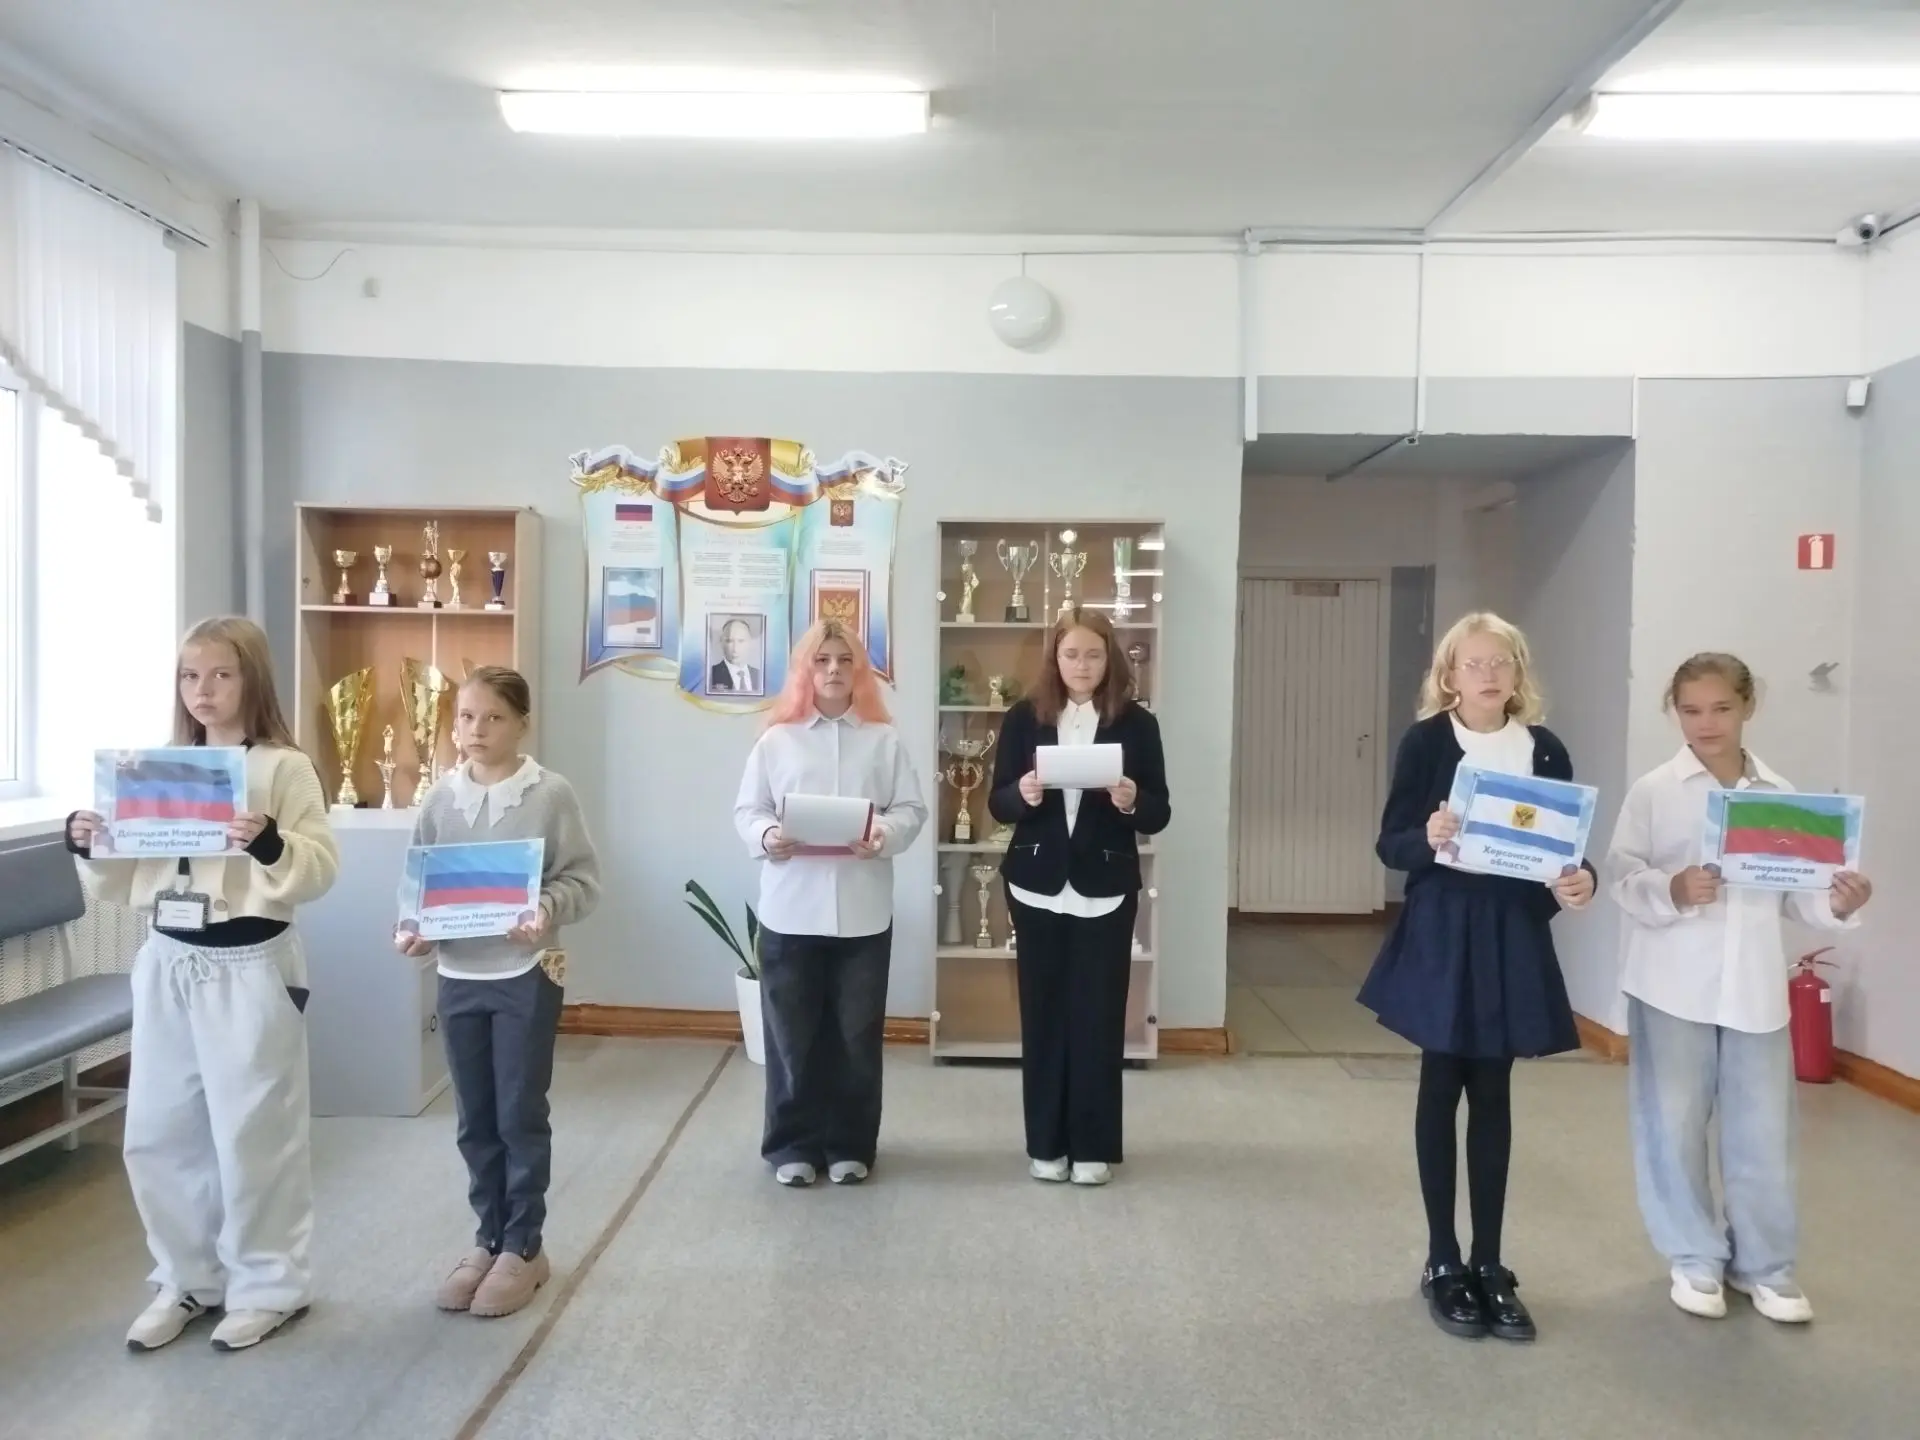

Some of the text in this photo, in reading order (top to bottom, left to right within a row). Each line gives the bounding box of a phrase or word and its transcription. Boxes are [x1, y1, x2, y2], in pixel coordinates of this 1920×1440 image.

[139, 839, 201, 849] Республика
[1483, 845, 1544, 863] Херсонская
[1490, 858, 1530, 872] область
[1740, 862, 1816, 875] Запорожская
[1754, 873, 1799, 883] область
